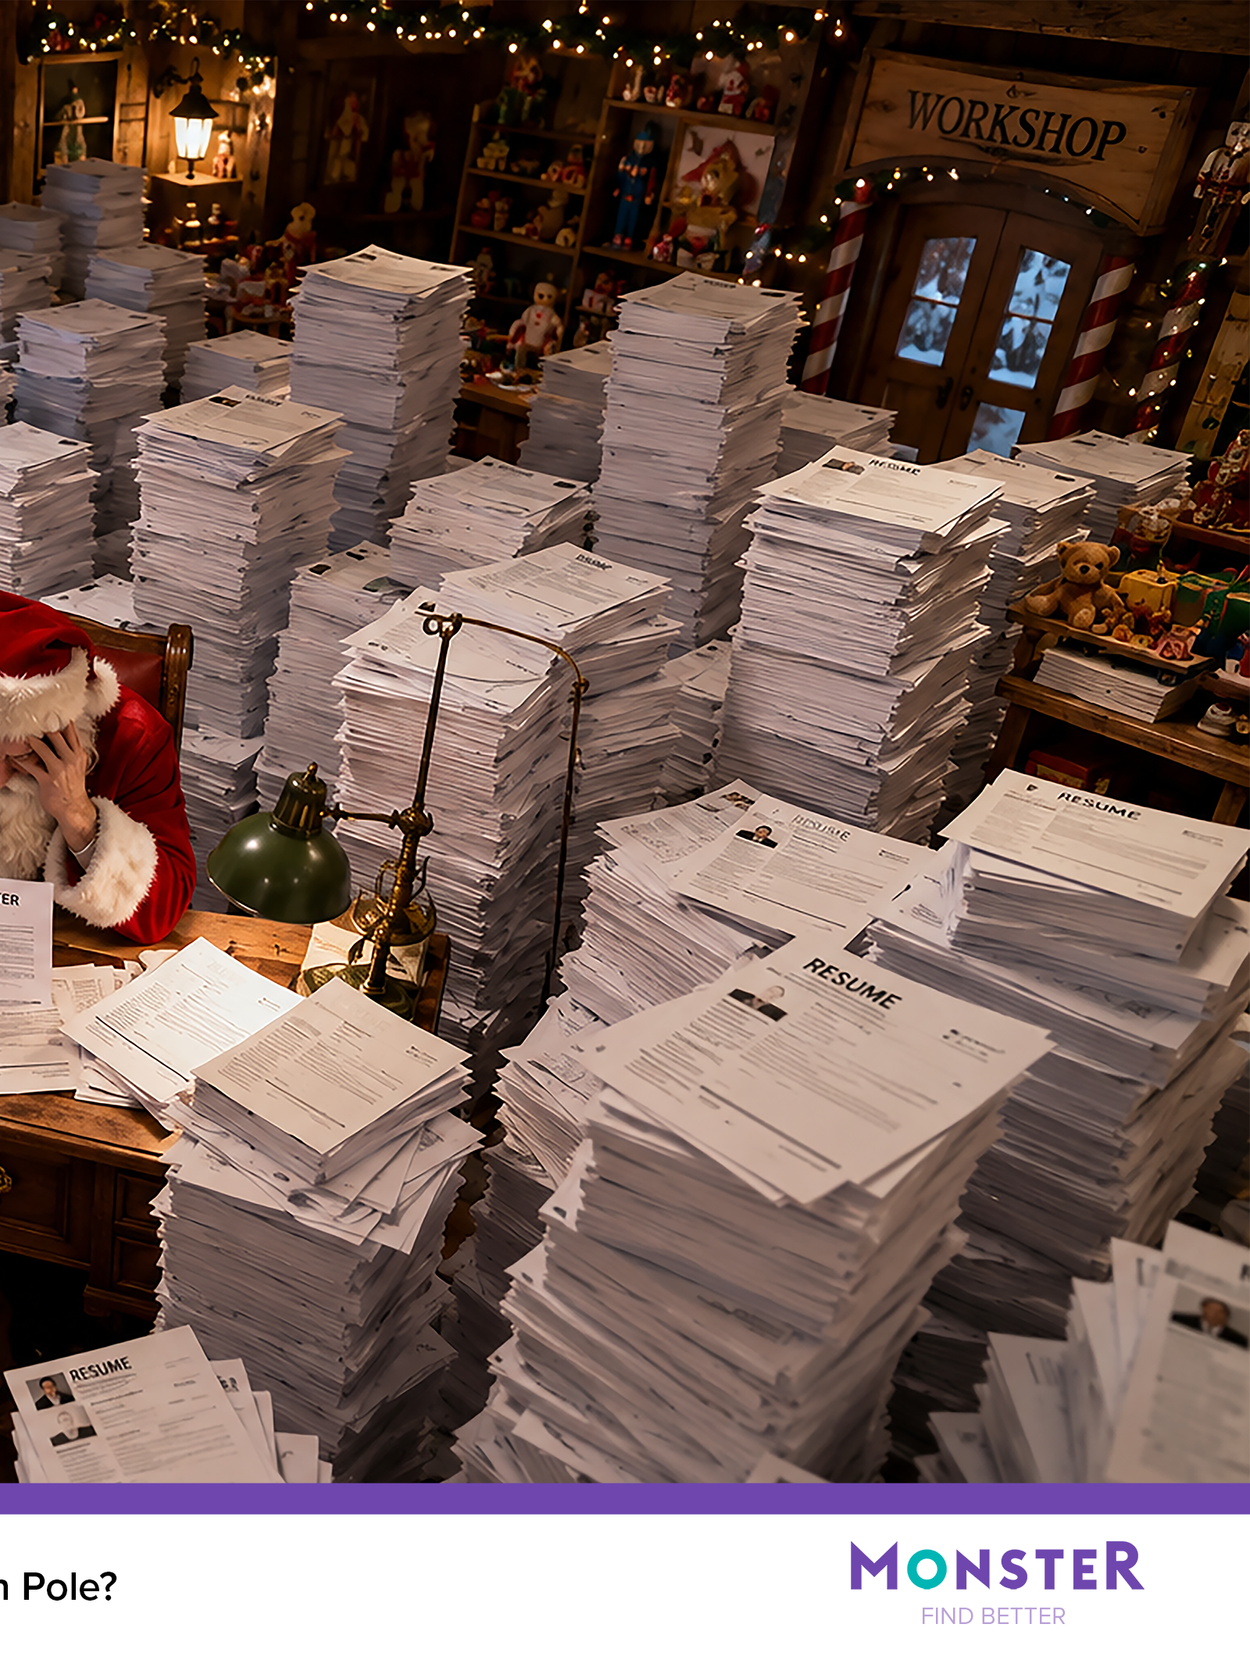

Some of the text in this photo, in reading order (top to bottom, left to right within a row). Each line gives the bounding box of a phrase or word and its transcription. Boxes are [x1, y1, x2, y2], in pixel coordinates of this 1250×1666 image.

[907, 88, 1127, 161] WORKSHOP
[1056, 791, 1142, 822] RESUME
[802, 957, 903, 1010] RESUME
[69, 1356, 132, 1383] RESUME
